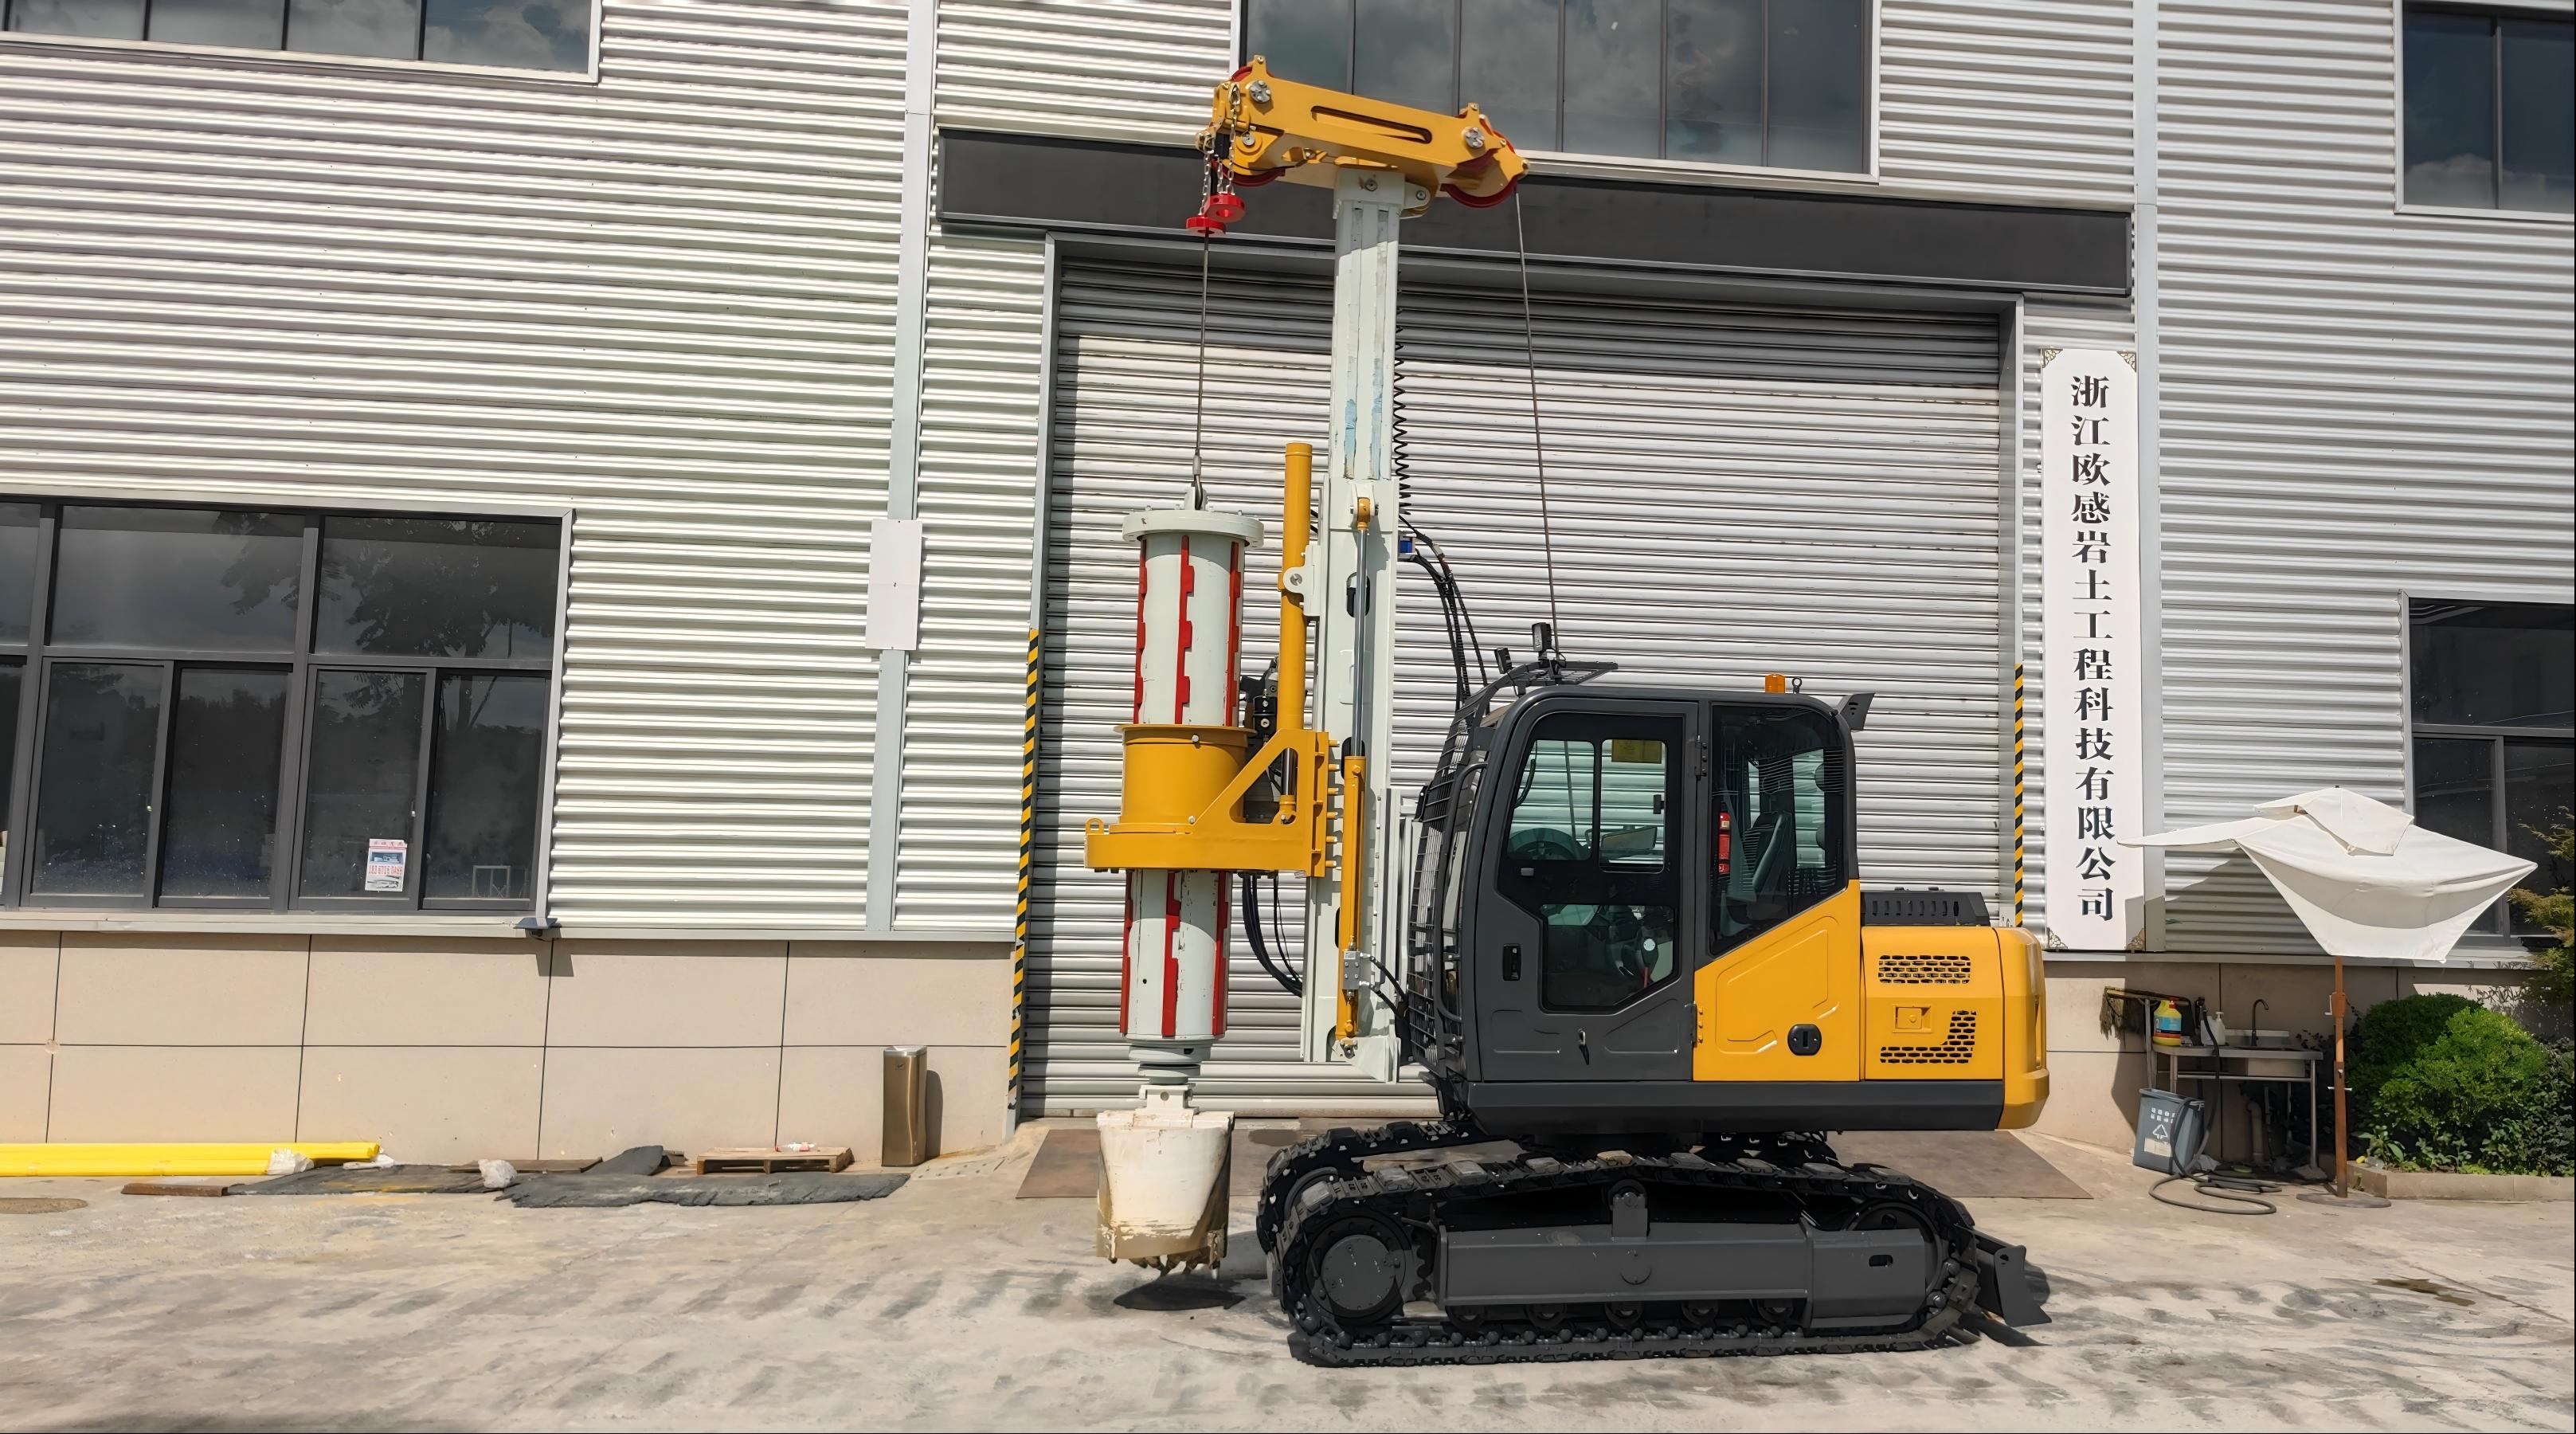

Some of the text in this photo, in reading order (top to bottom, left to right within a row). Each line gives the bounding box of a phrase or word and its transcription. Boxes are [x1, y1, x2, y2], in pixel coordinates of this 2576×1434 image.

[2070, 375, 2116, 921] 浙江欧感岩土工程科技有限公司
